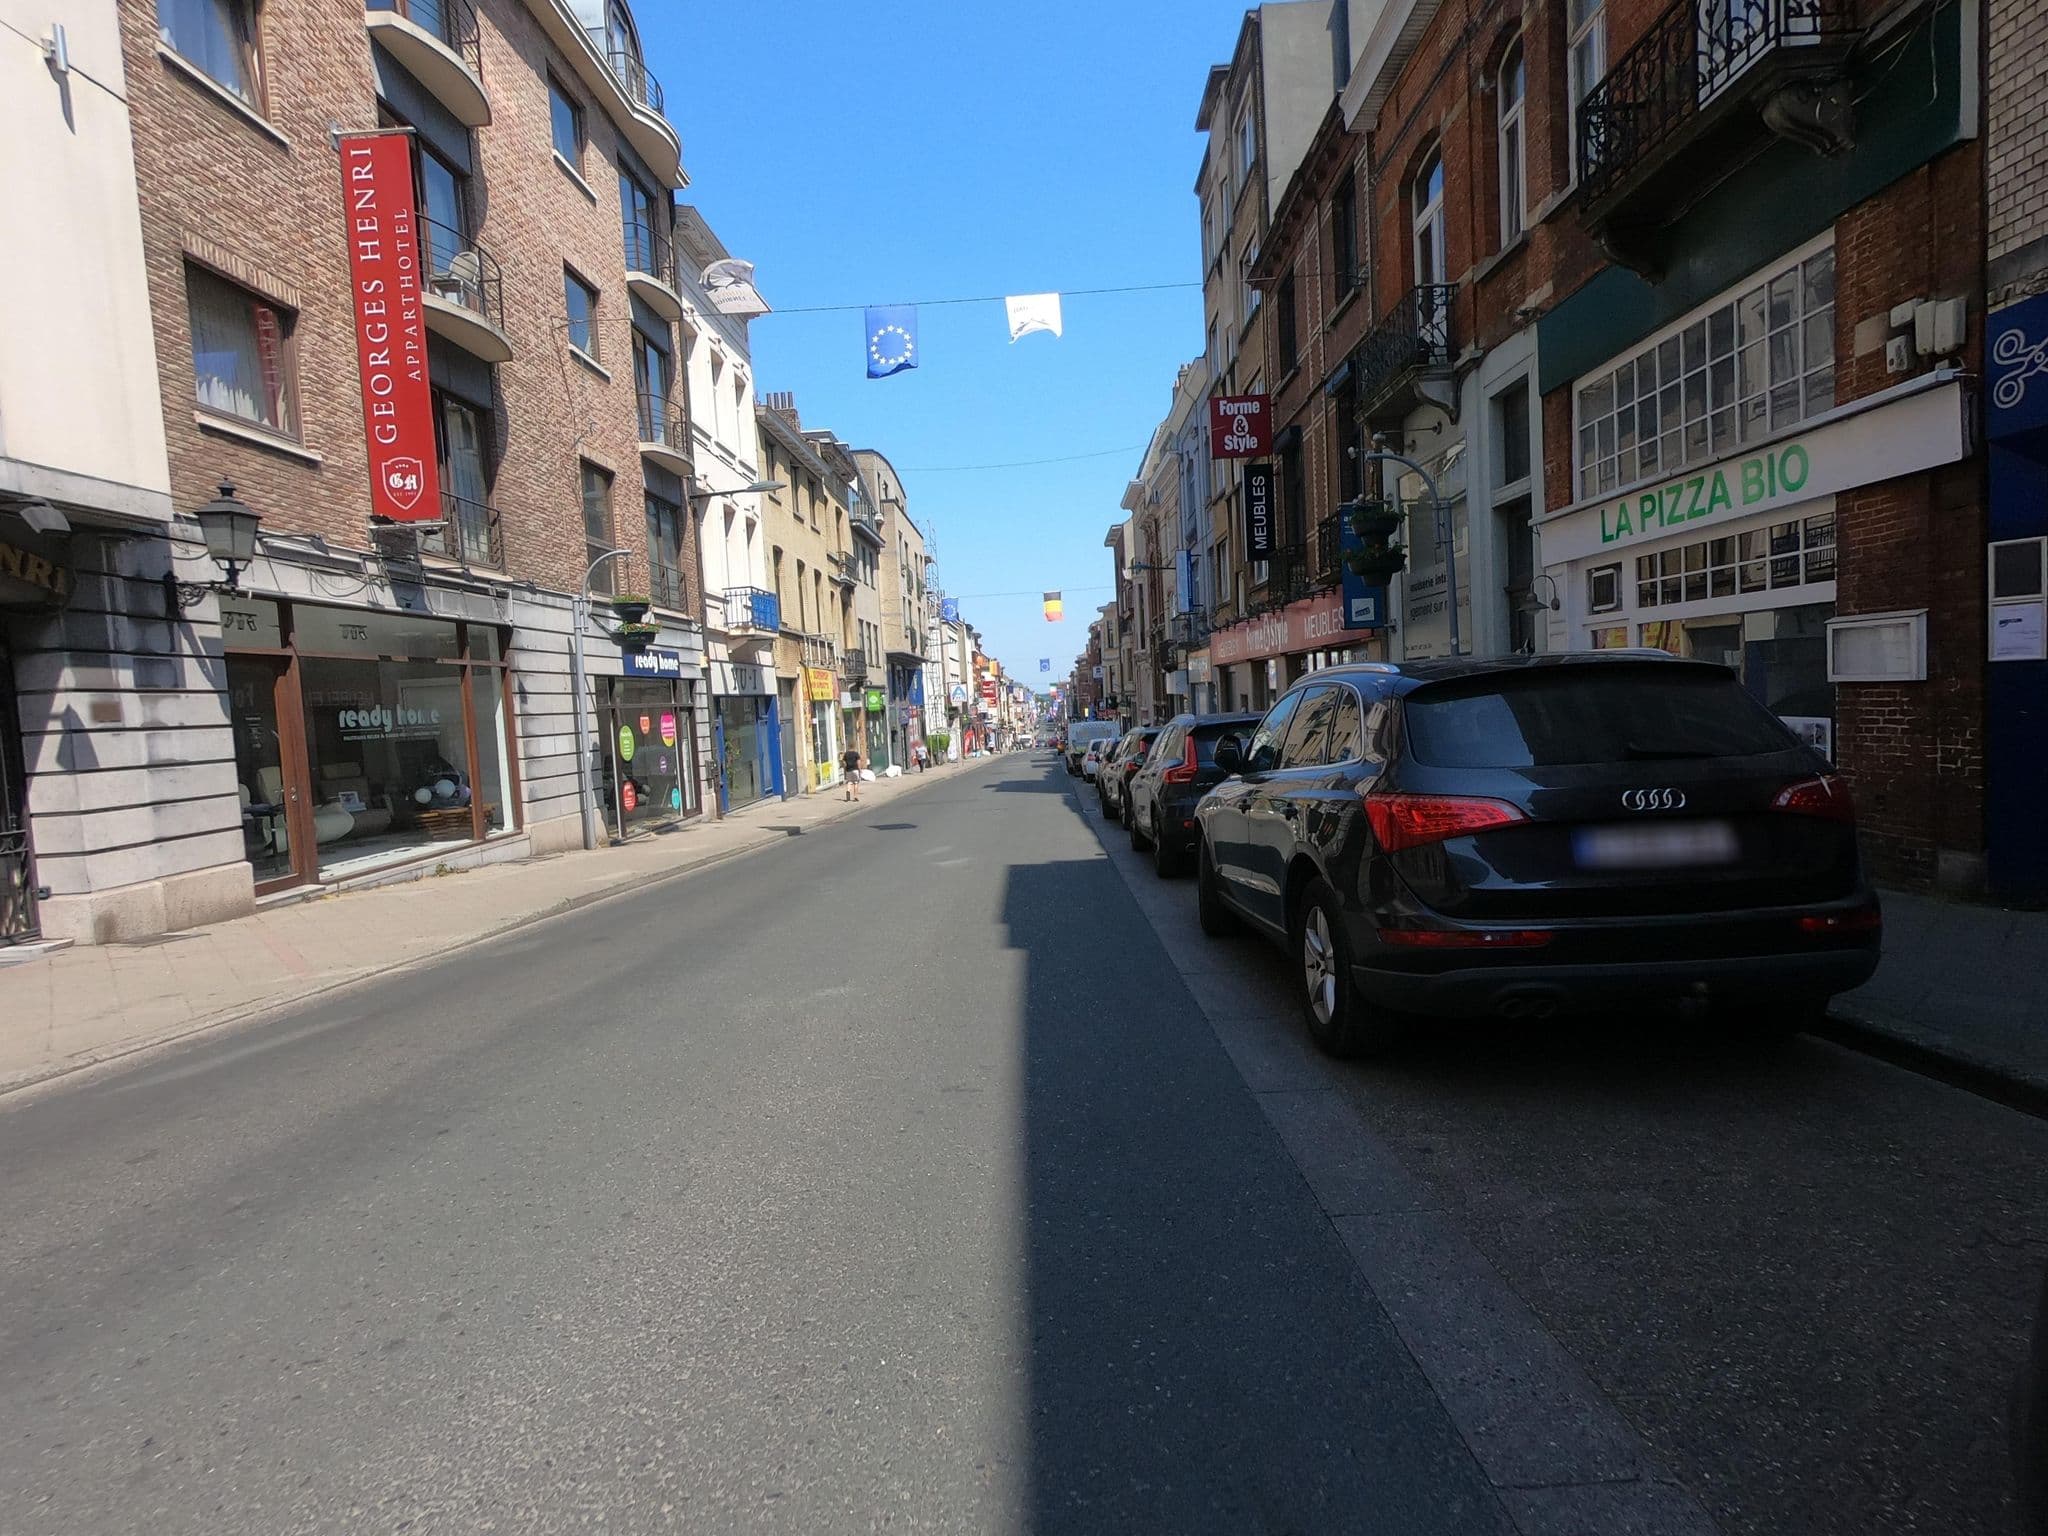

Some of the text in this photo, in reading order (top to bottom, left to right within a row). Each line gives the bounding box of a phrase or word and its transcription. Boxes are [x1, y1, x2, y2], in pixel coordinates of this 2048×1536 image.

[350, 147, 397, 445] GEORGES HENRI
[393, 208, 422, 382] APPARTHOTEL
[1218, 399, 1260, 416] Forme
[1234, 417, 1247, 434] &
[1224, 434, 1258, 453] Style
[1600, 444, 1810, 544] LA PIZZA BIO
[1253, 475, 1268, 550] MEUBLES
[1304, 606, 1345, 641] MEUBLES
[635, 651, 679, 674] ready home
[338, 704, 393, 733] ready
